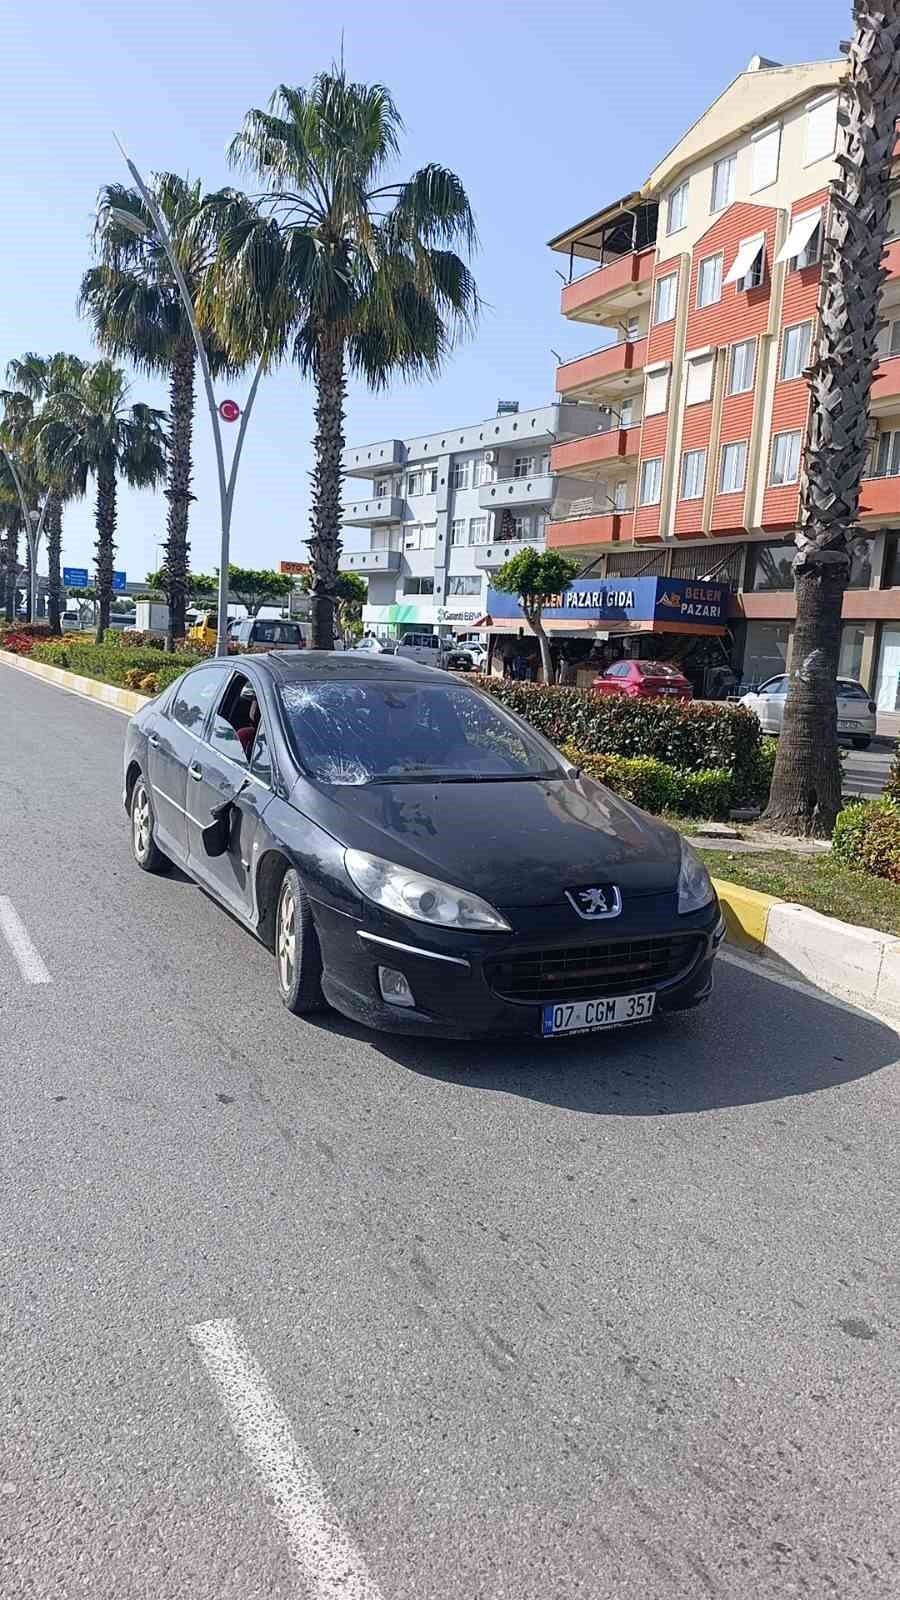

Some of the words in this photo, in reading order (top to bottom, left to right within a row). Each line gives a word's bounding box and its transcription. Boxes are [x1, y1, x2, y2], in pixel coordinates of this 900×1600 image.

[566, 591, 603, 608] PAZARI
[606, 591, 634, 608] GIDA
[685, 587, 721, 602] BELEN
[680, 603, 721, 617] PAZARI
[554, 1005, 575, 1029] 07
[585, 1000, 617, 1024] CGM
[626, 994, 654, 1018] 351
